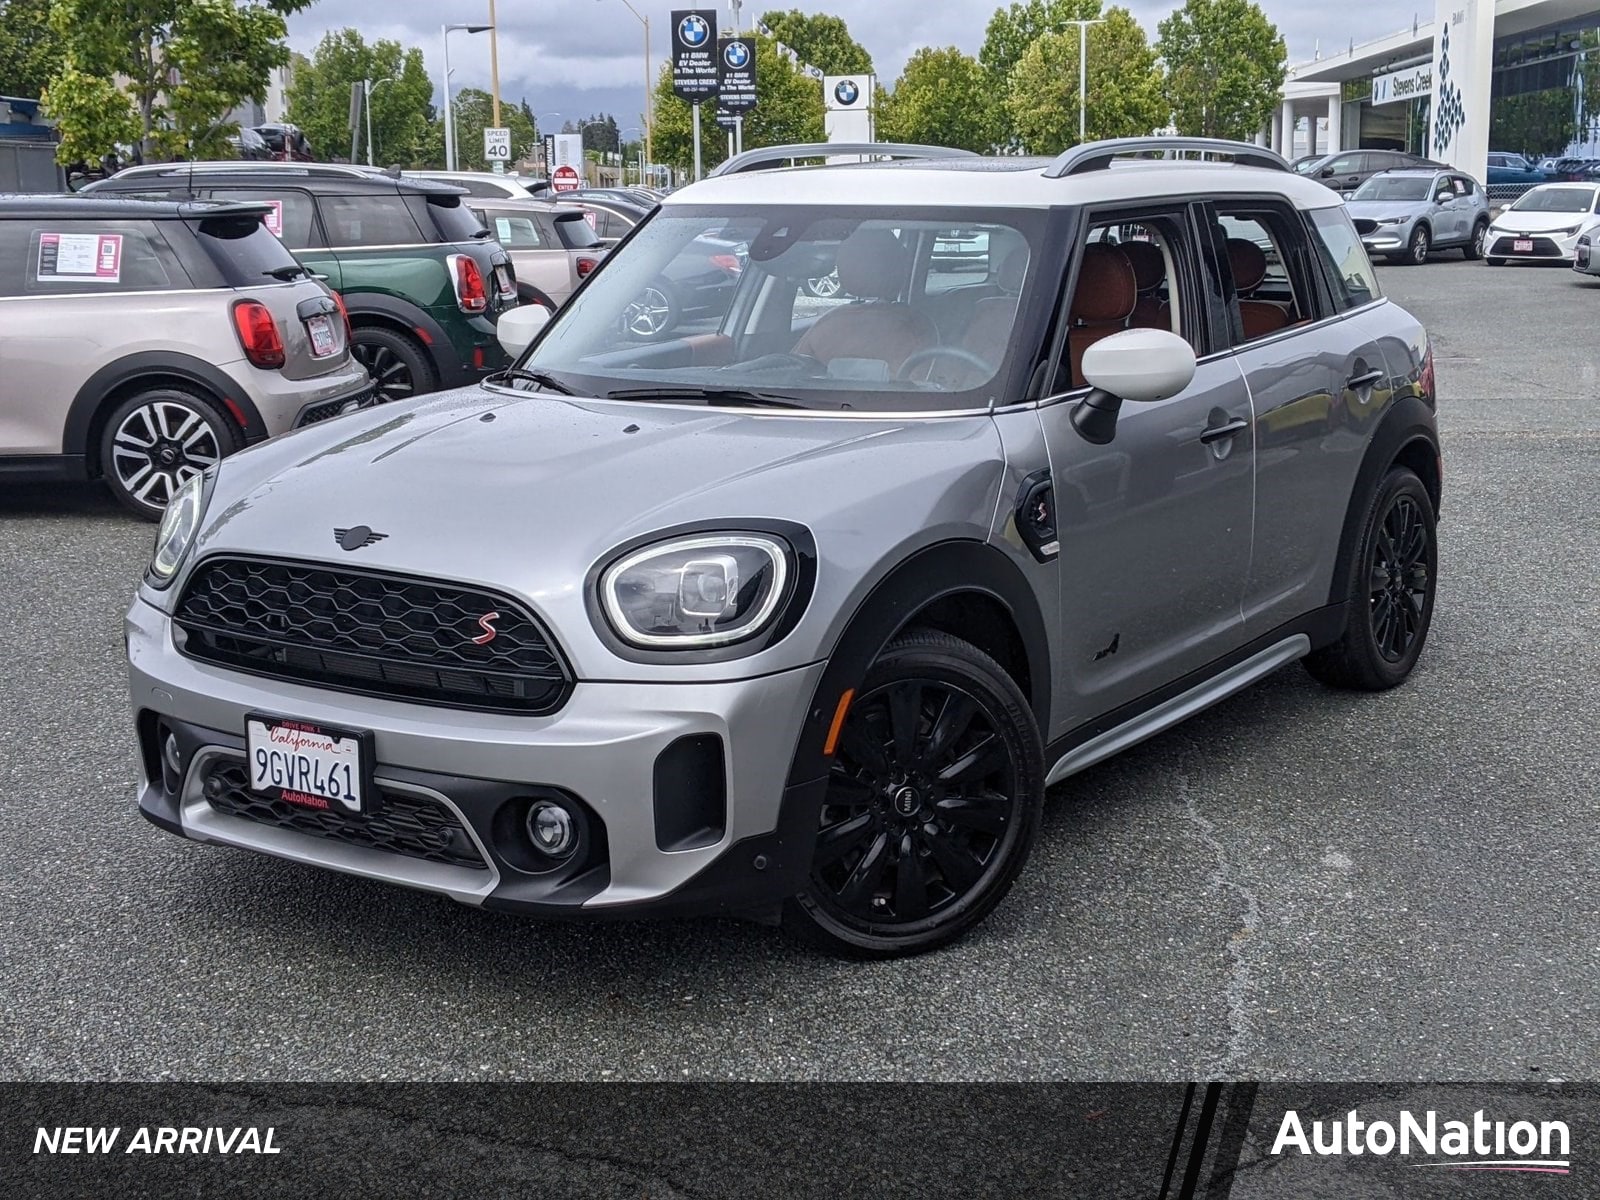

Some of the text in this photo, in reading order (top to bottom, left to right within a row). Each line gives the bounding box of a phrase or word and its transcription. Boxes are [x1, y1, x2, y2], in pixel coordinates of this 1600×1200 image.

[698, 78, 717, 86] CREEK
[1392, 70, 1433, 97] Stevens Creek
[487, 145, 508, 157] 40
[471, 611, 501, 645] S
[281, 721, 316, 732] DRIVE PINK
[270, 725, 341, 754] California
[256, 748, 357, 802] 9GVR461
[281, 790, 329, 809] AutoNation
[903, 790, 912, 812] MINI
